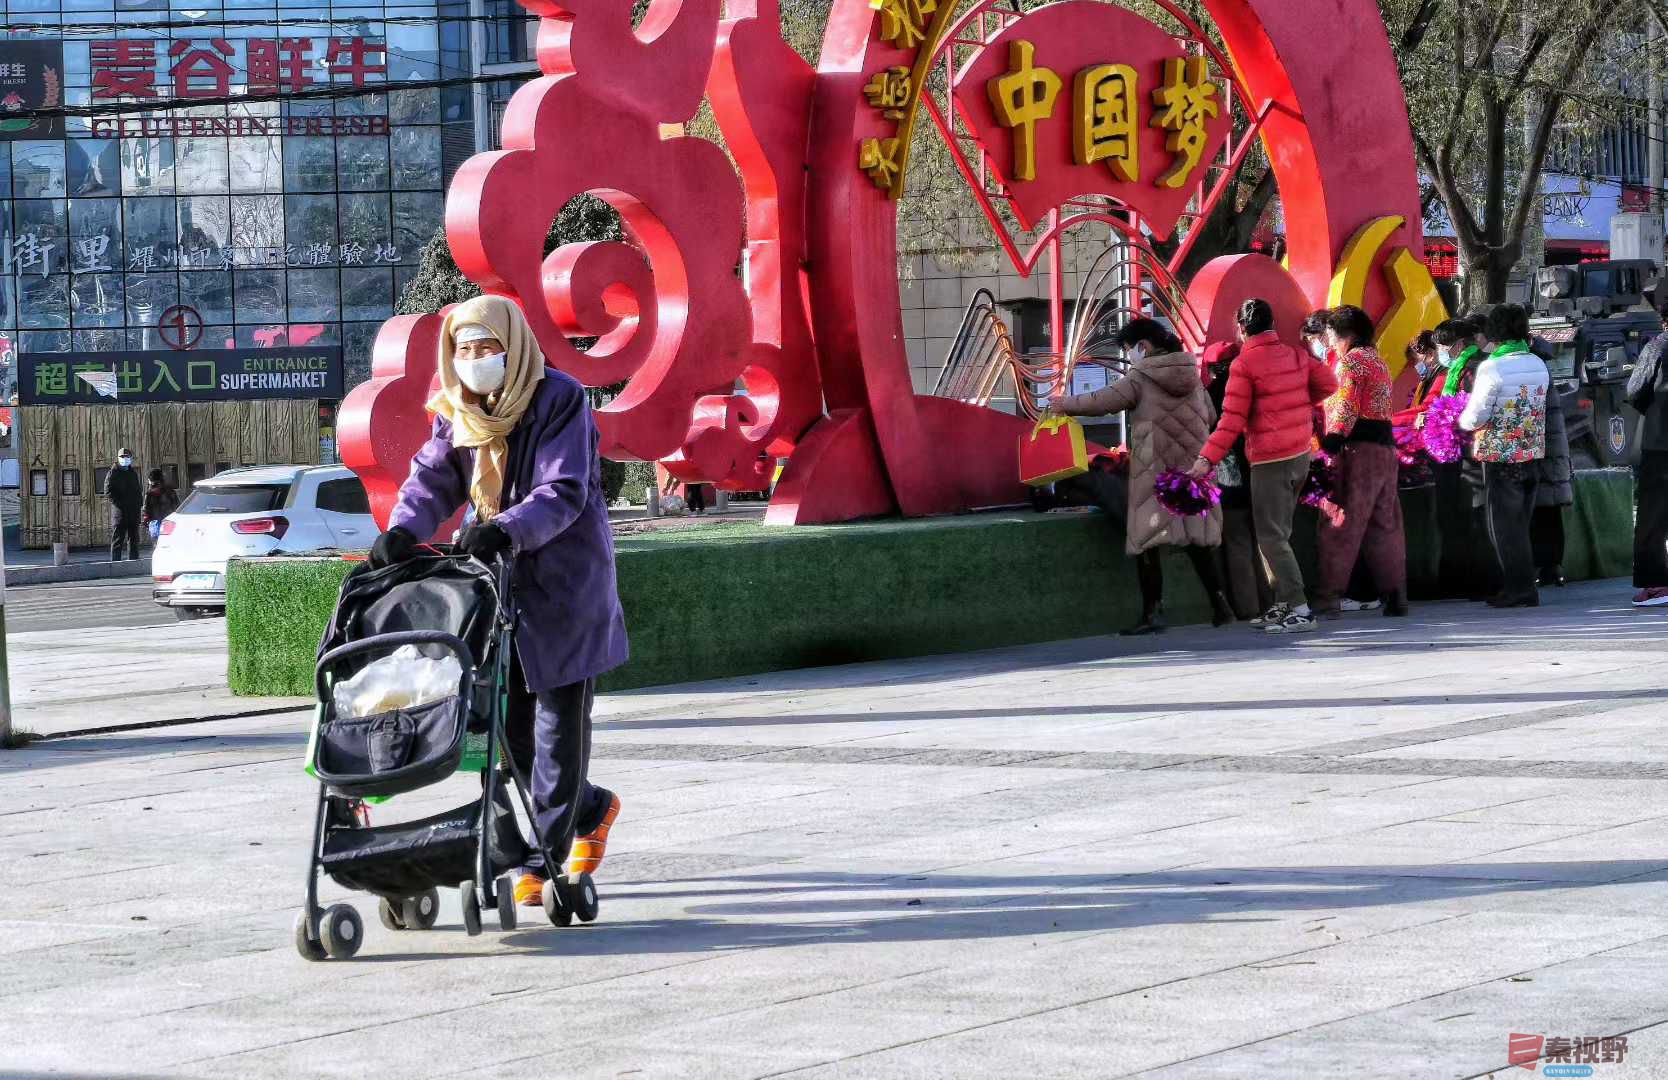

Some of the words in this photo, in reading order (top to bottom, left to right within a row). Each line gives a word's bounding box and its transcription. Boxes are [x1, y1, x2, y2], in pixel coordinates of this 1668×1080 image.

[987, 39, 1218, 189] 中国梦
[92, 117, 271, 138] GLUTENIN
[288, 115, 390, 136] FRESH
[1544, 196, 1583, 217] BANK
[243, 357, 328, 371] ENTRANCE
[35, 360, 216, 396] 超市出入口
[221, 372, 328, 390] SUPERMARKET
